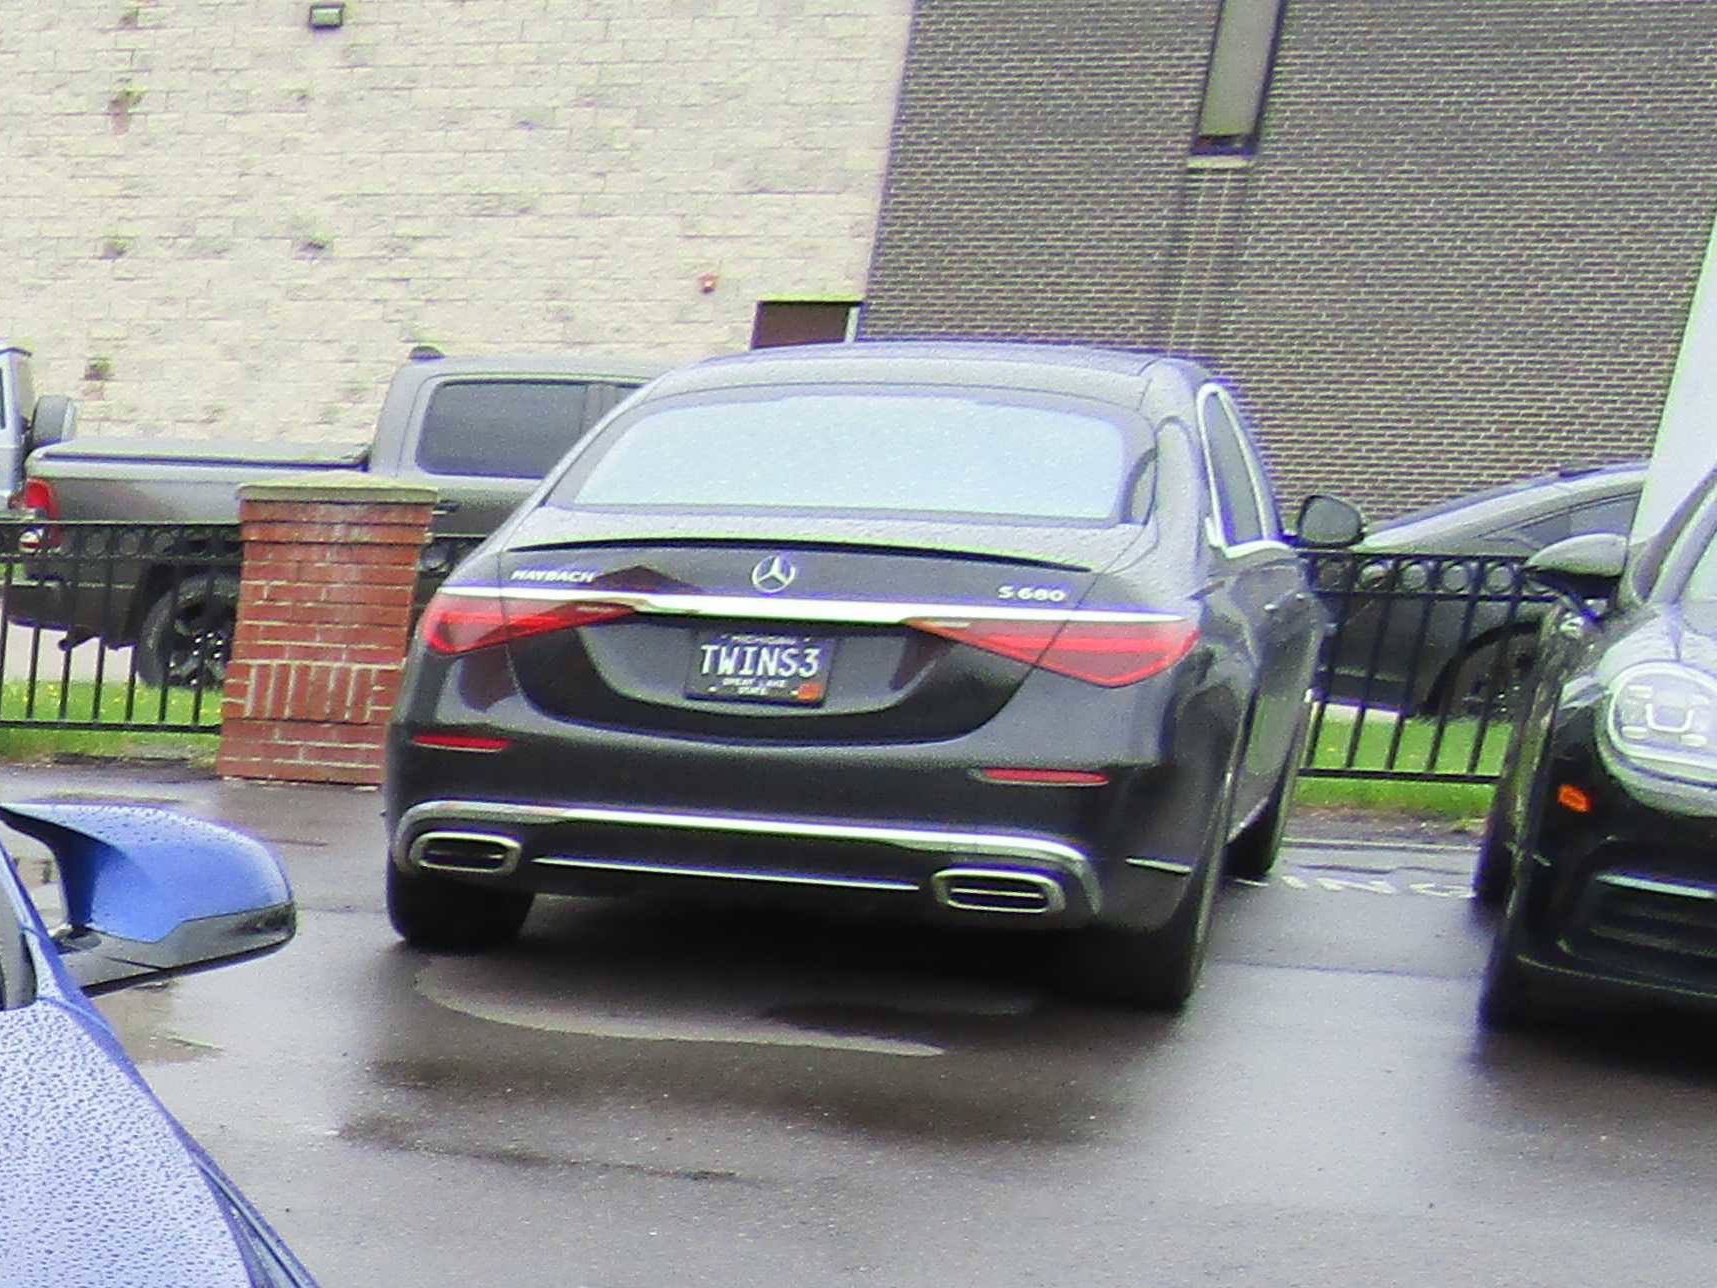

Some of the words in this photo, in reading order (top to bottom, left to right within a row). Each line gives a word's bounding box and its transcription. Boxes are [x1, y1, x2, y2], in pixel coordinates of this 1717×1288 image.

[509, 570, 597, 583] MAYBACH
[997, 585, 1014, 599] S
[1016, 587, 1066, 602] 680
[700, 644, 822, 678] TWINS3
